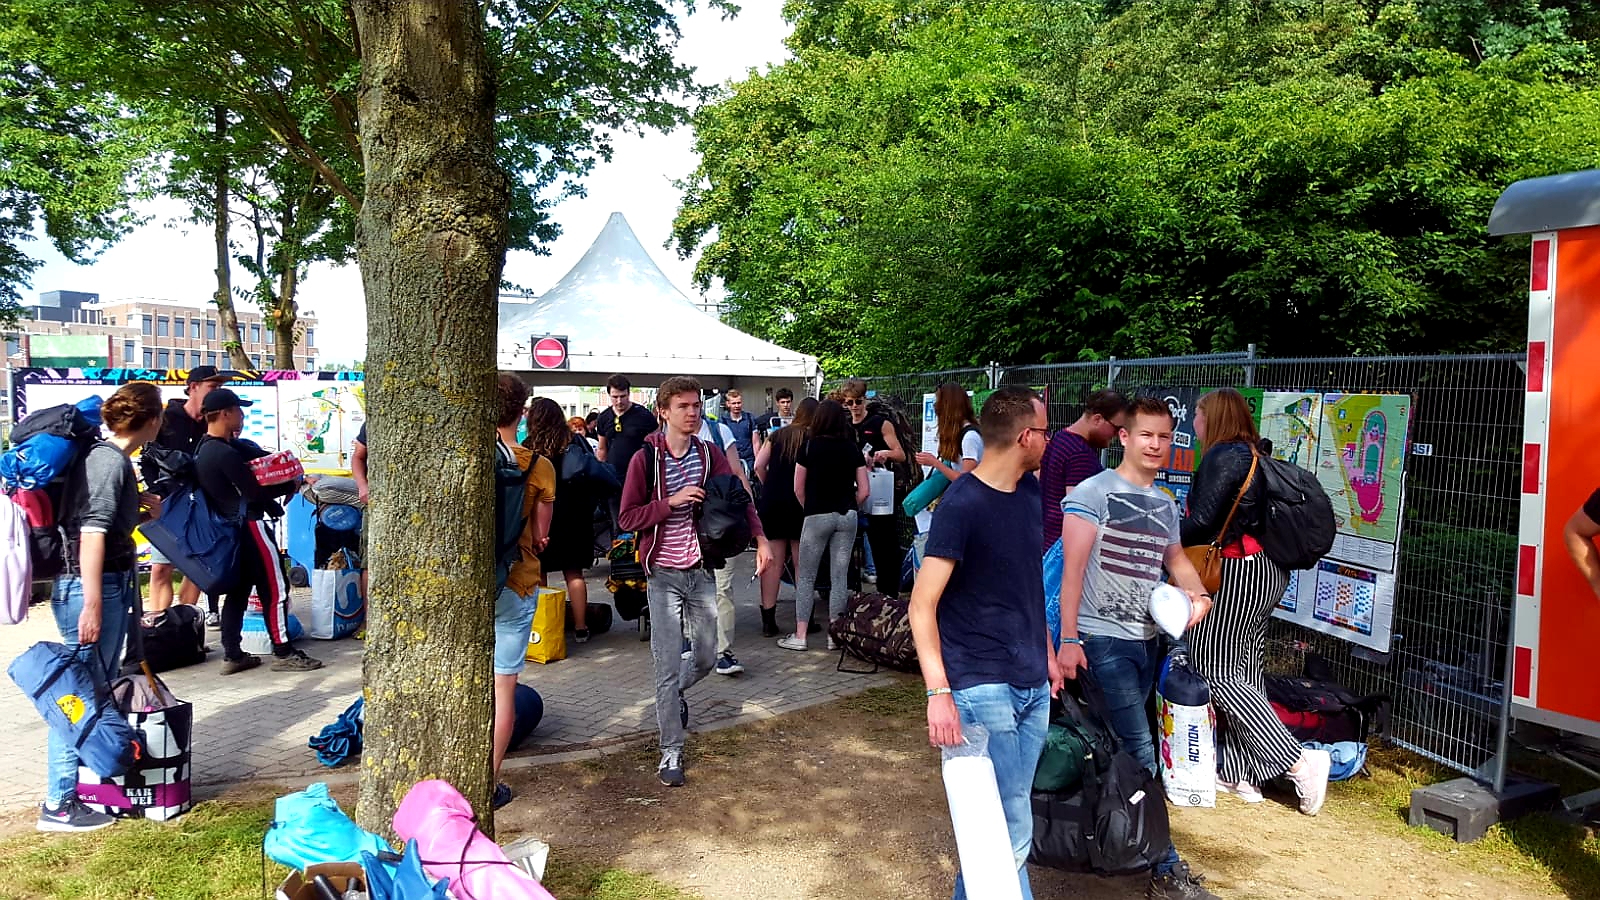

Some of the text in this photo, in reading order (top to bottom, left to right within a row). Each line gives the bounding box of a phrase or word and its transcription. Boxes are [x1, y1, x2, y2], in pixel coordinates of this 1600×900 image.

[1188, 724, 1199, 762] ACTION
[126, 788, 152, 797] KAR
[130, 797, 152, 805] WEI
